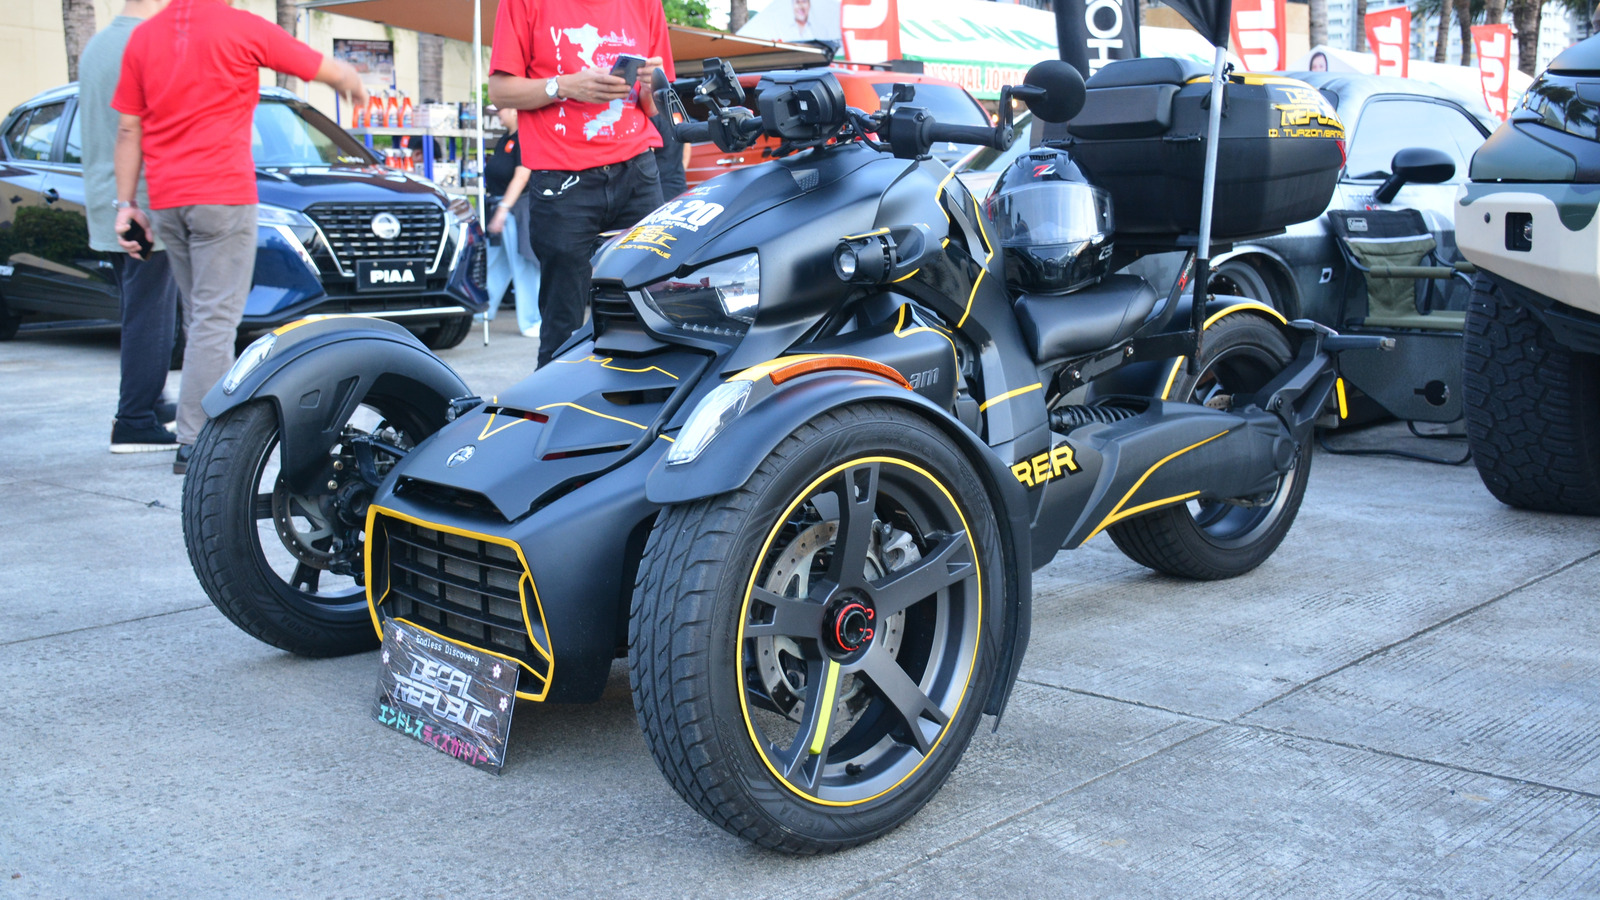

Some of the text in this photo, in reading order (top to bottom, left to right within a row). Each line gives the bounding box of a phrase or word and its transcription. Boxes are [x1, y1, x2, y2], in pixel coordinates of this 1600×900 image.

[370, 269, 415, 283] PIAA
[415, 635, 480, 666] Endless Discovery
[407, 652, 485, 707] DECAL
